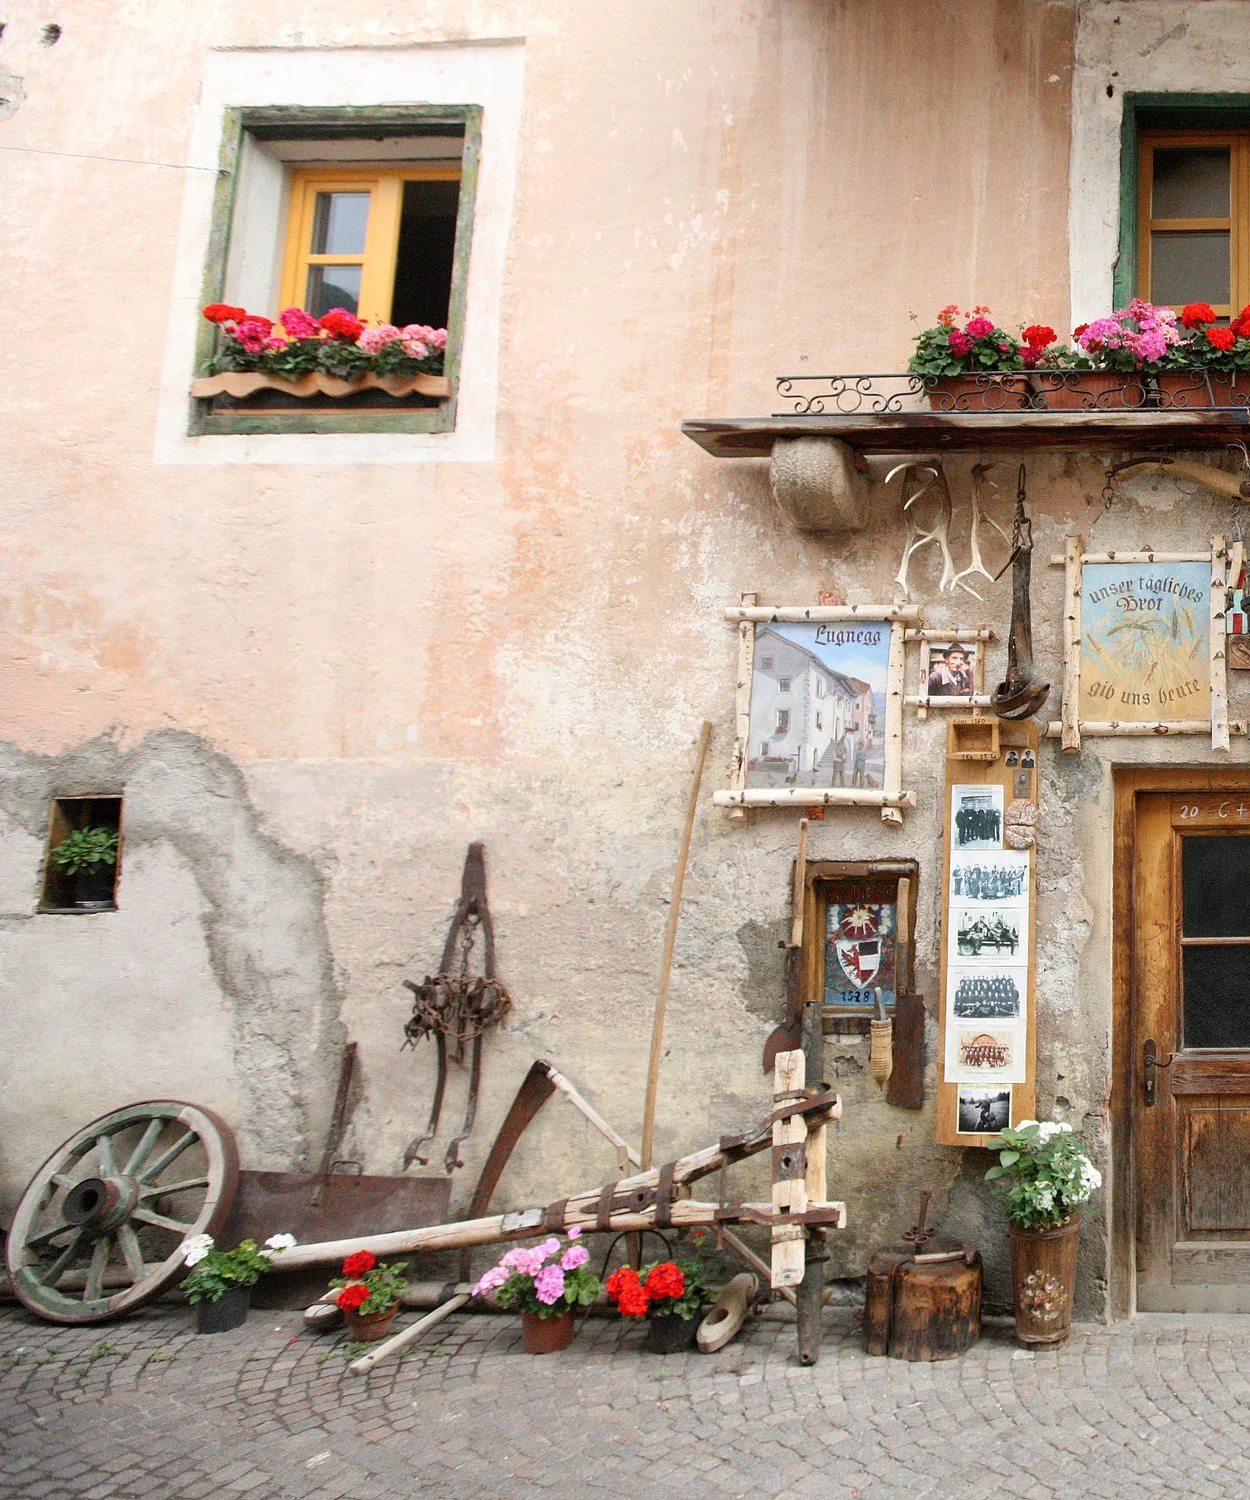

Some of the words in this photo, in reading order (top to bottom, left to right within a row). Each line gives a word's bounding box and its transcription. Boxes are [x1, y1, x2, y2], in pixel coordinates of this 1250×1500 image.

[1089, 579, 1133, 604] unser
[1138, 574, 1204, 603] tägliches
[1116, 595, 1164, 614] Brot
[814, 624, 881, 647] Lugnegg
[1087, 681, 1115, 700] gib
[1120, 690, 1151, 705] uns
[1158, 679, 1200, 705] heute
[1180, 805, 1199, 819] 20
